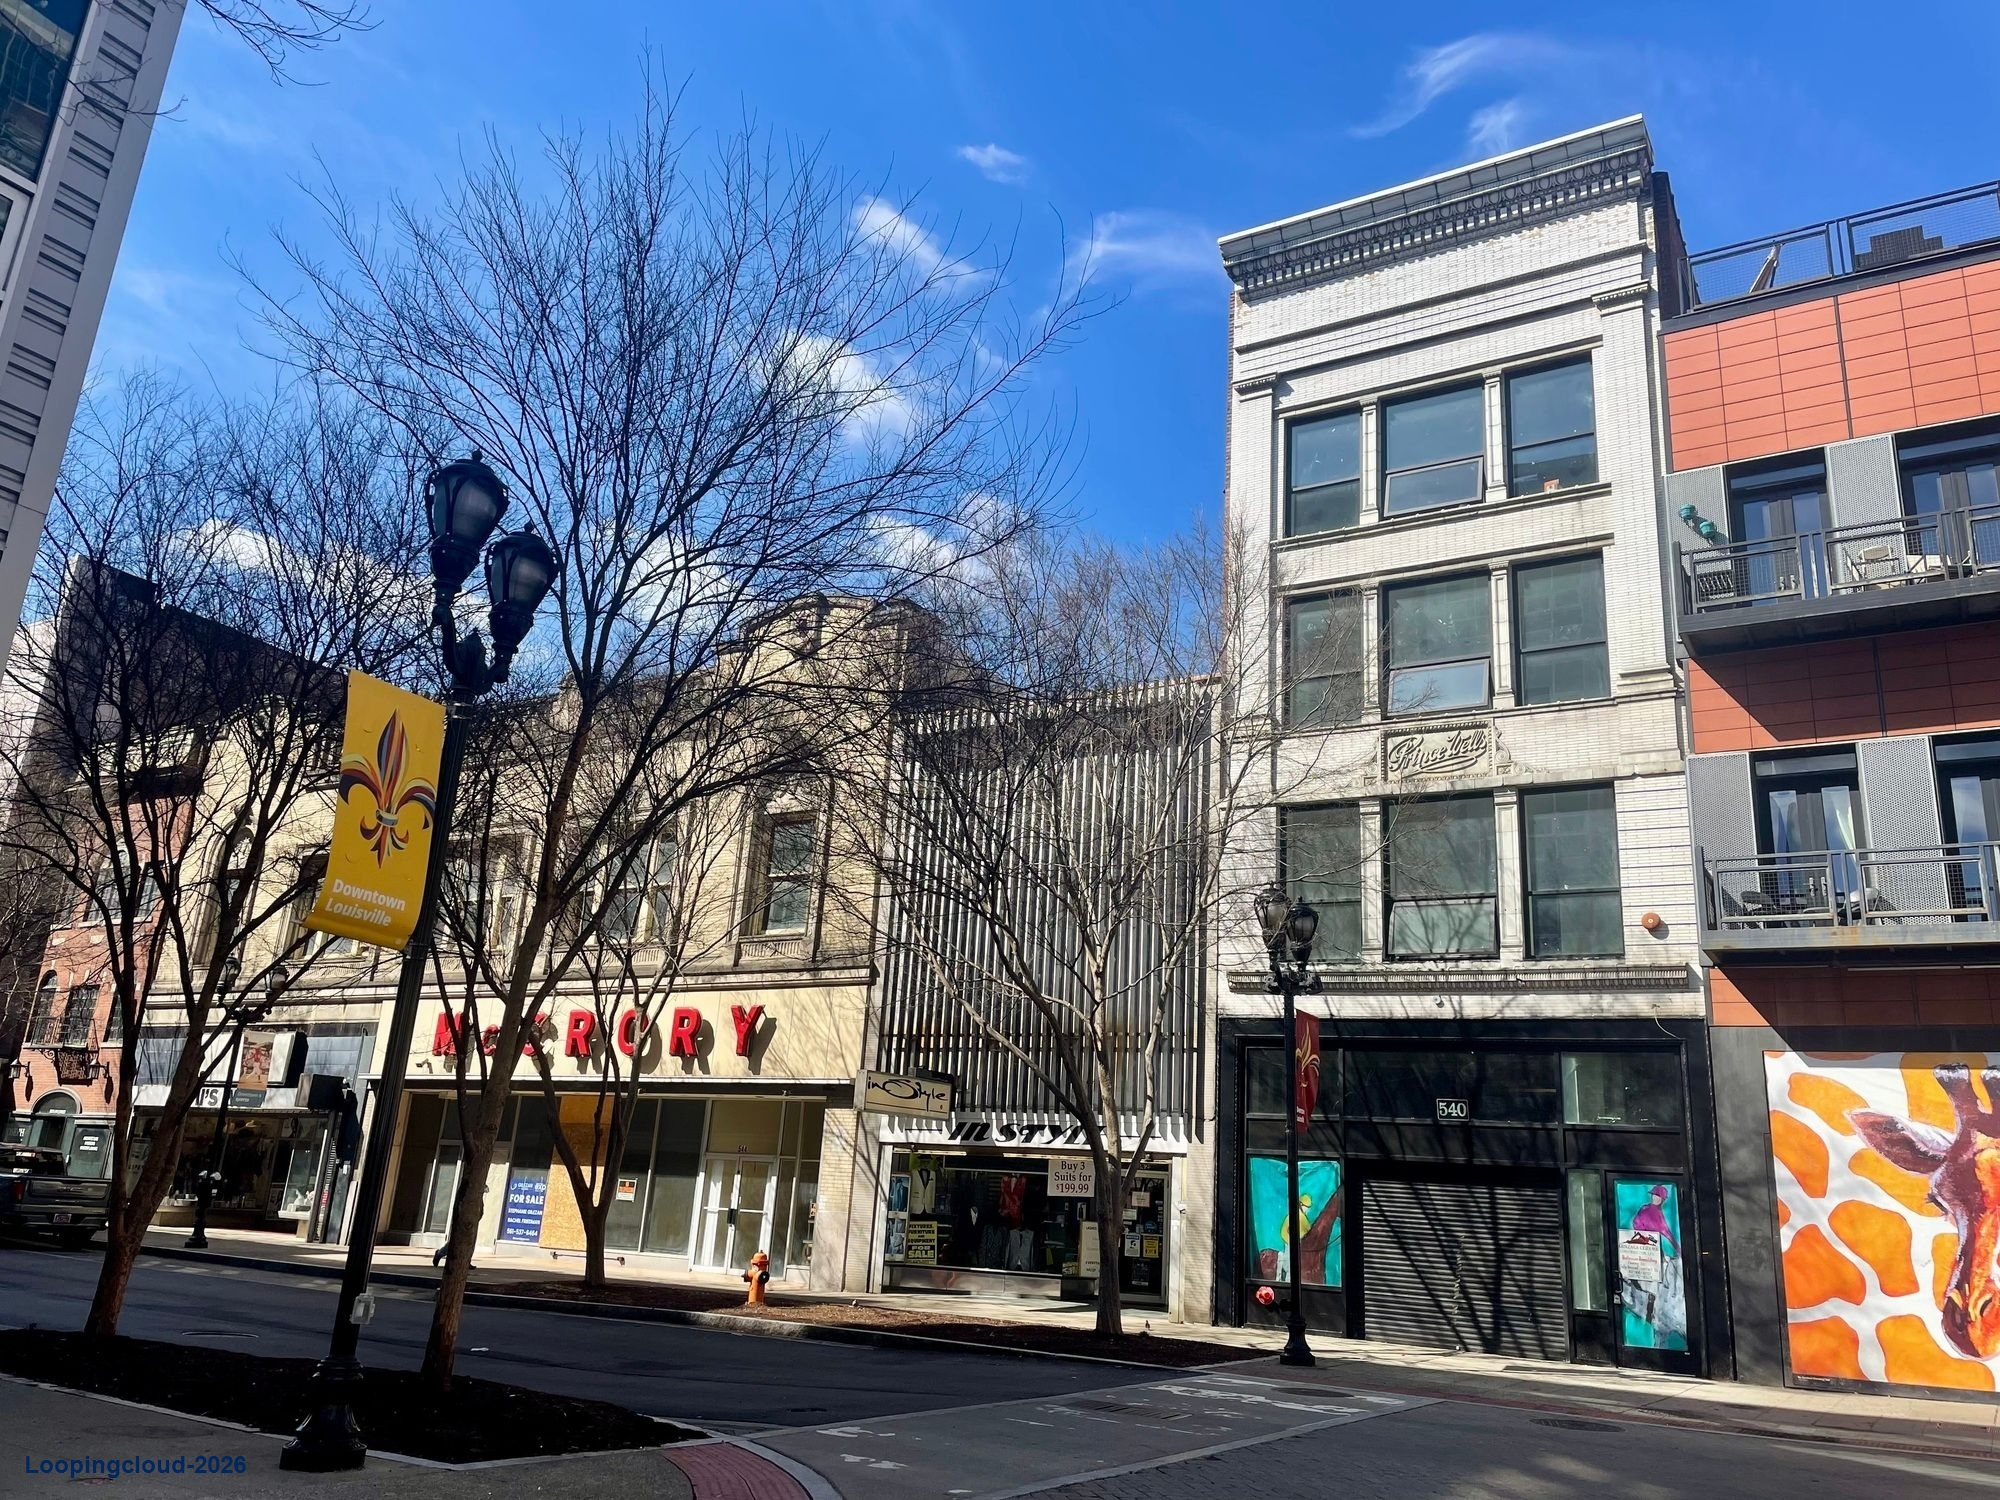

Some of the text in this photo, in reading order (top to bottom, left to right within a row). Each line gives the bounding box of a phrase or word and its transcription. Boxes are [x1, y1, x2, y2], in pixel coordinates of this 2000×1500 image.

[332, 879, 406, 911] Downtown
[325, 898, 392, 927] Louisville
[1439, 1102, 1467, 1117] 540
[995, 1123, 1107, 1145] STYL
[1061, 1161, 1085, 1173] Buy 3
[1054, 1172, 1092, 1182] Suits for
[1056, 1183, 1089, 1194] $199.99
[509, 1194, 544, 1204] FOR SALE
[908, 1250, 934, 1258] SALE
